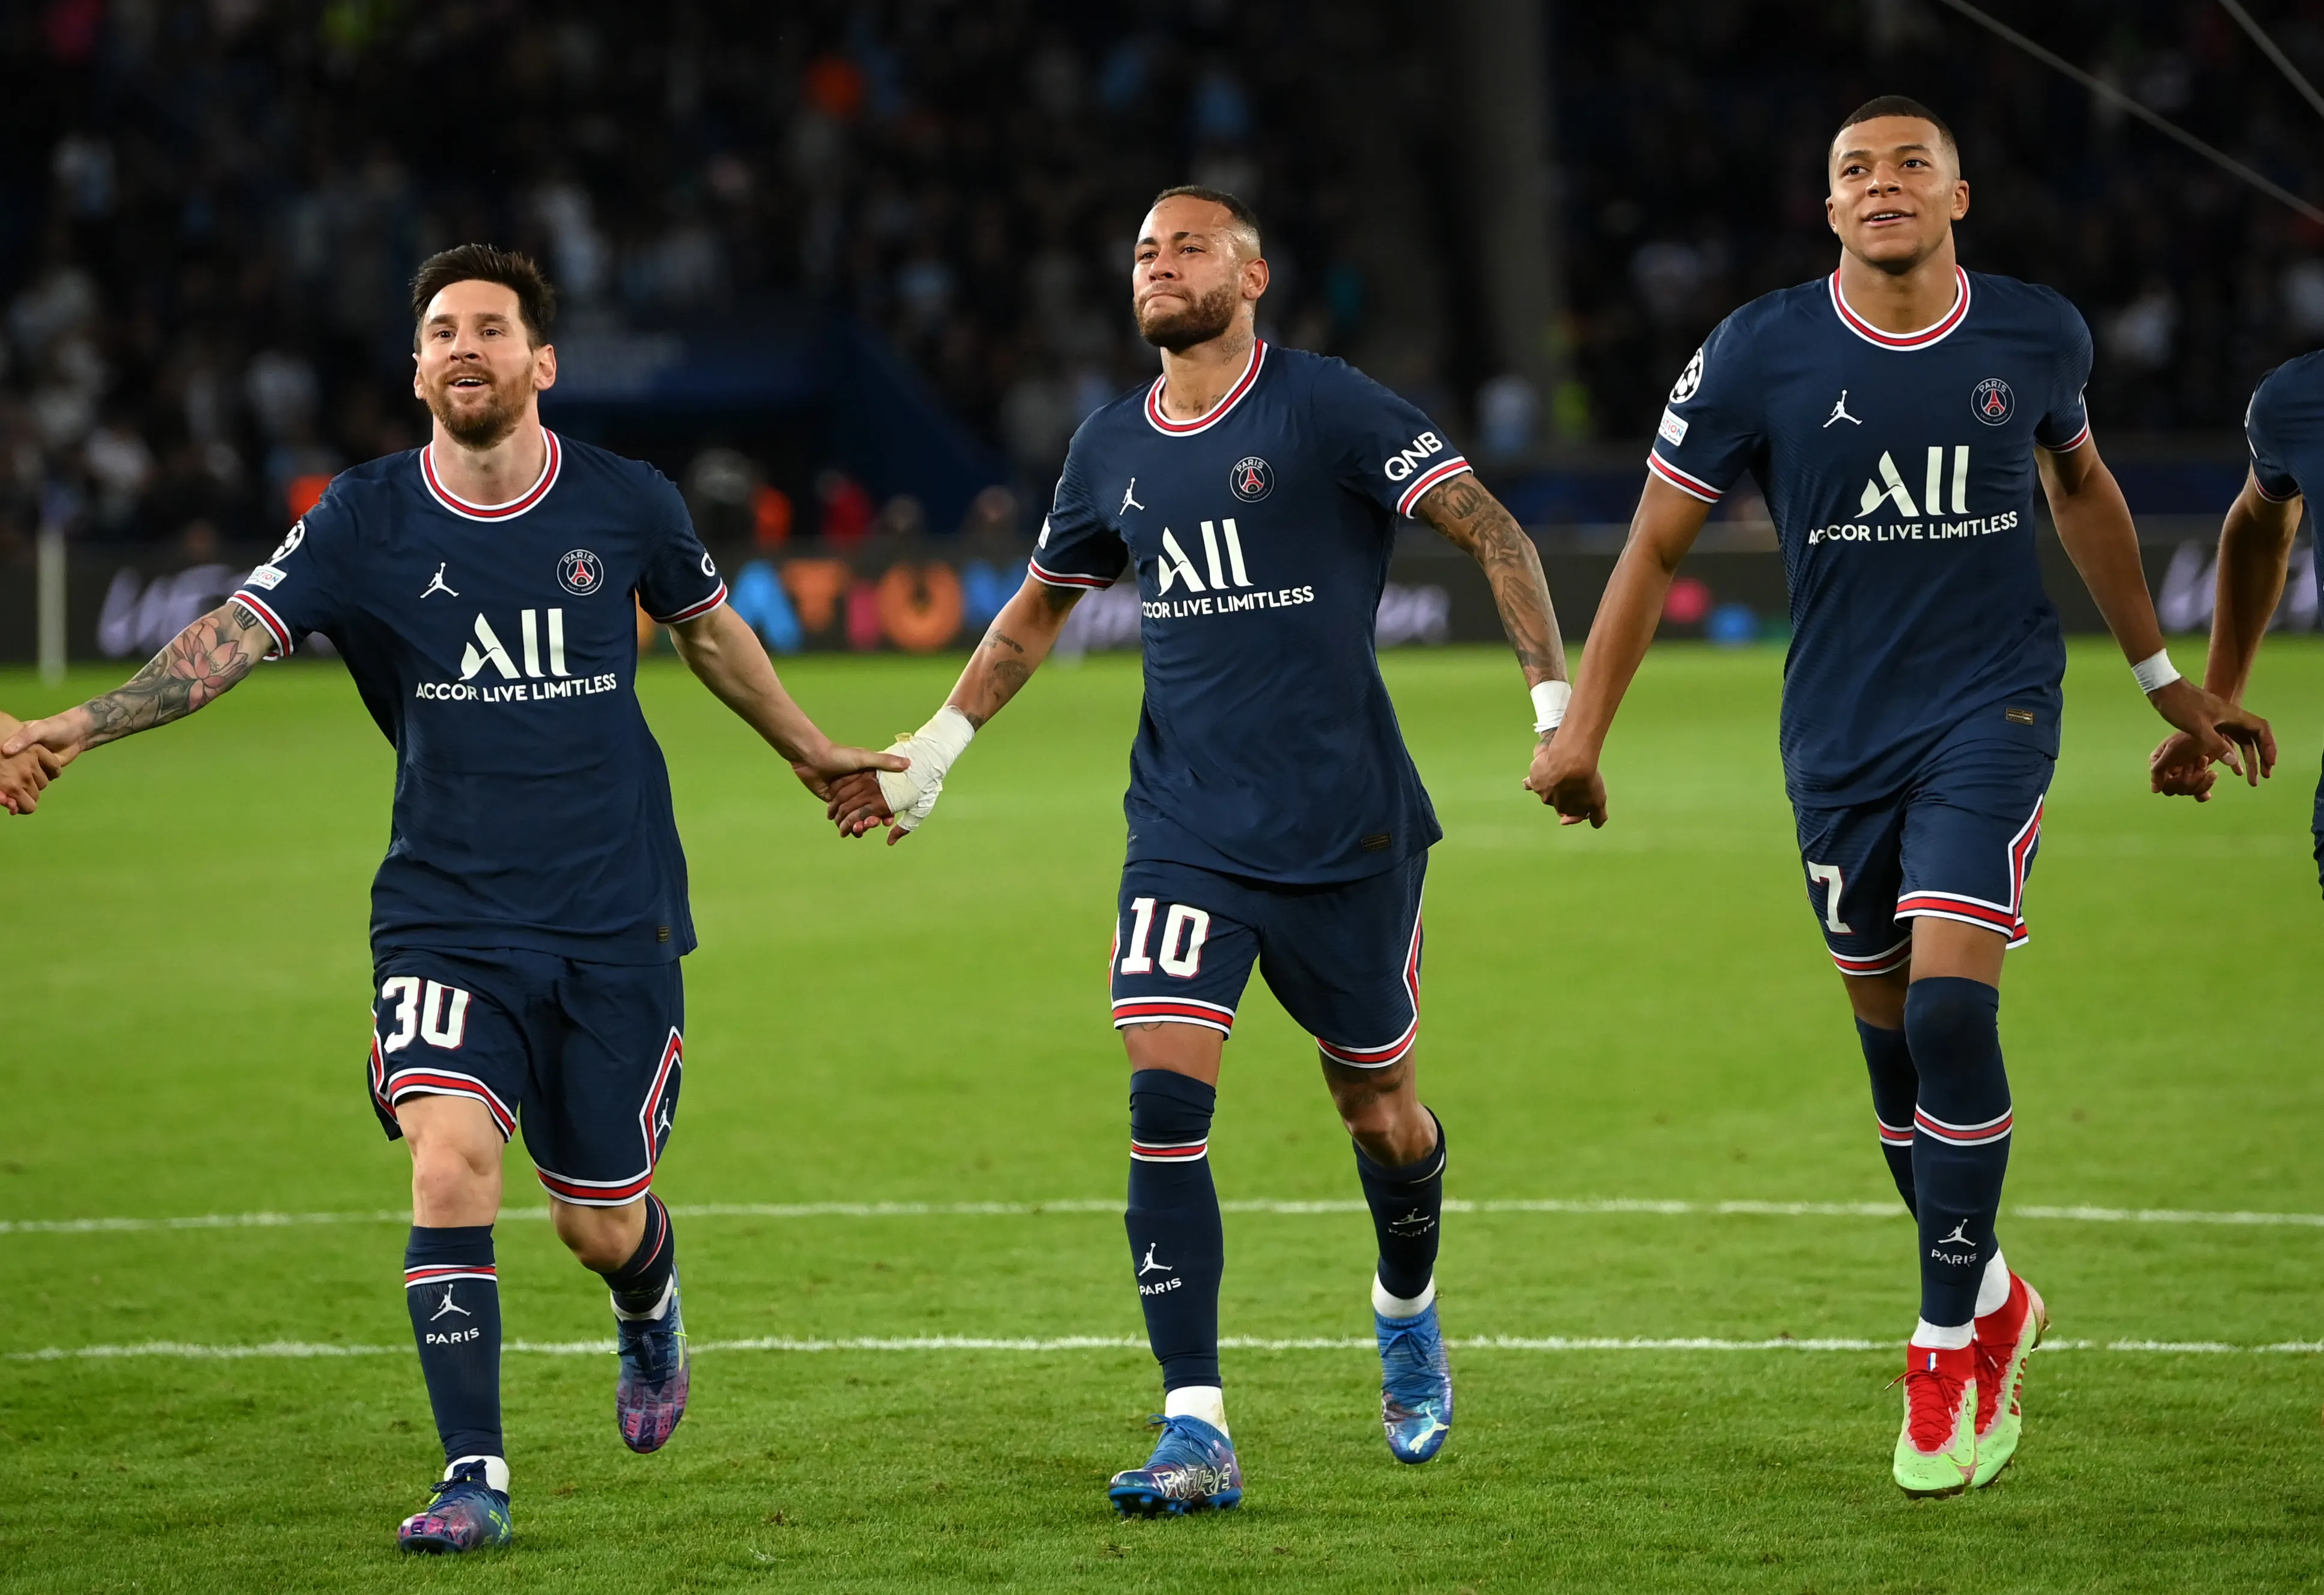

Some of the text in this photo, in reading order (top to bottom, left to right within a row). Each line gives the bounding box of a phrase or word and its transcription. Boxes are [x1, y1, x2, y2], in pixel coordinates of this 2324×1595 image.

[1978, 380, 2007, 392] PARIS
[1236, 459, 1264, 472] PARIS
[1385, 432, 1444, 481] QNB
[1877, 524, 1923, 541] LIVE
[1929, 511, 2018, 538] LIMITLESS
[564, 552, 594, 564] PARIS
[1173, 598, 1213, 617] LIVE
[1217, 586, 1314, 613] LIMITLESS
[415, 673, 617, 702] ACCOR LIVE LIMITLESS
[1807, 861, 1855, 935] 7
[1121, 897, 1210, 979] 10
[382, 977, 472, 1054] 30
[1931, 1249, 1977, 1264] PARIS
[1139, 1278, 1182, 1296] PARIS
[425, 1327, 480, 1344] PARIS
